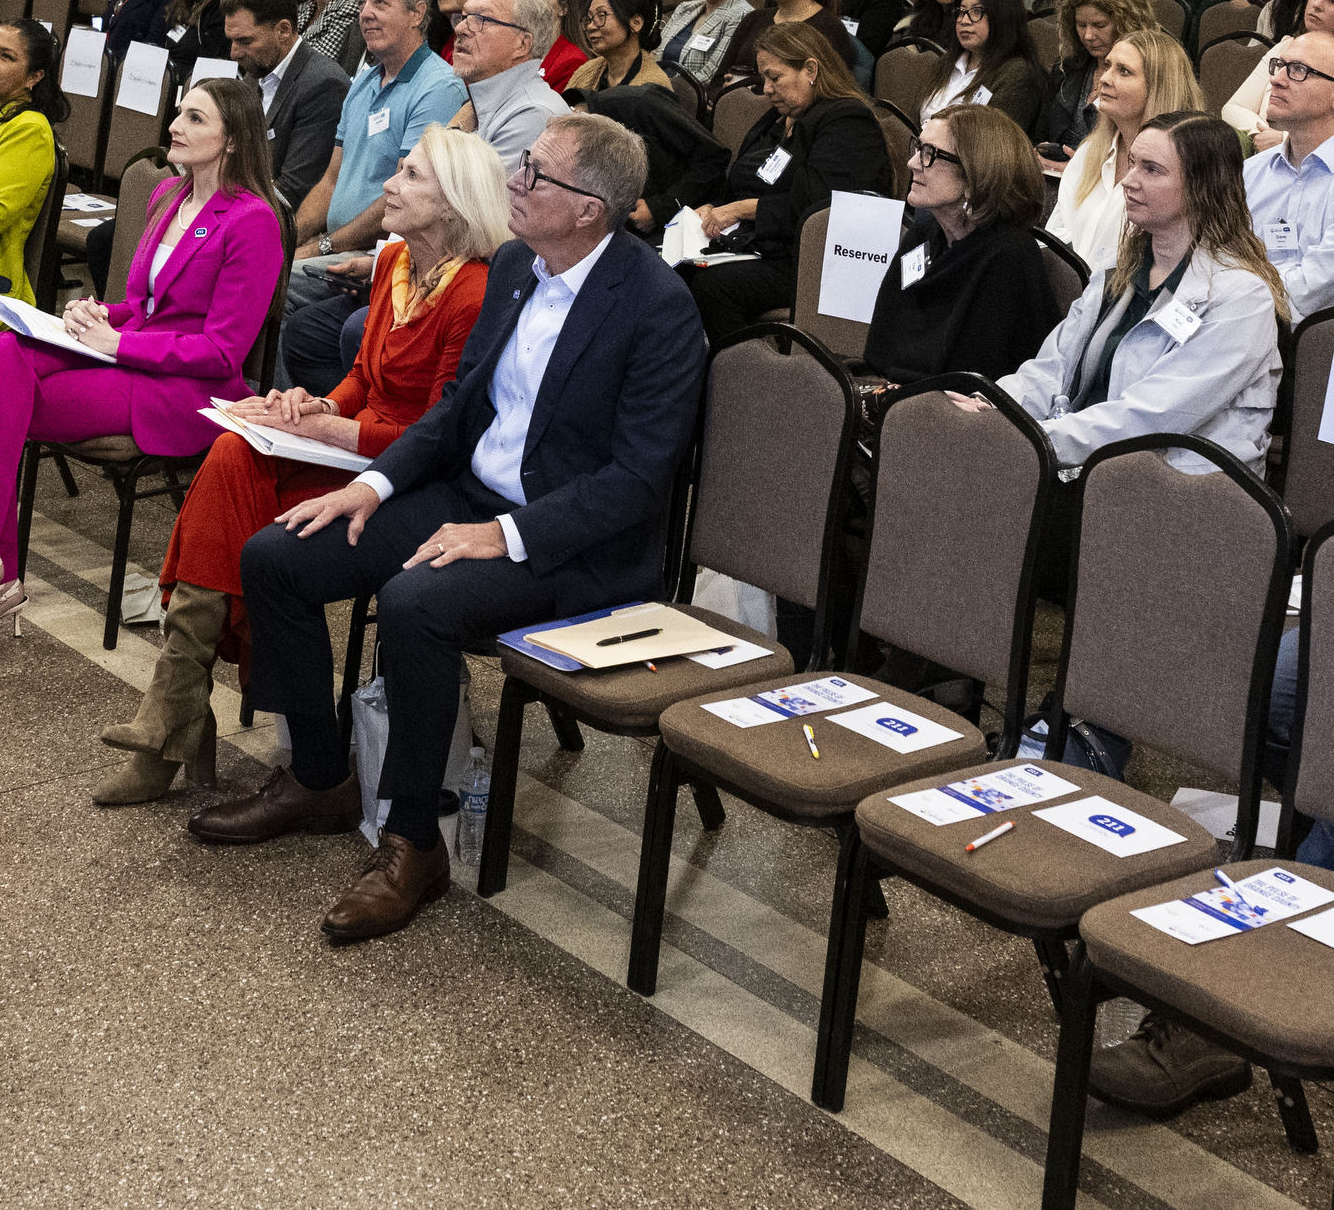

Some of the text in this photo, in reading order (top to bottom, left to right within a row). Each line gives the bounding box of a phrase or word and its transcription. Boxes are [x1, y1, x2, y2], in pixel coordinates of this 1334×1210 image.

[833, 244, 888, 264] Reserved
[882, 719, 910, 732] 211
[1095, 817, 1125, 831] 211
